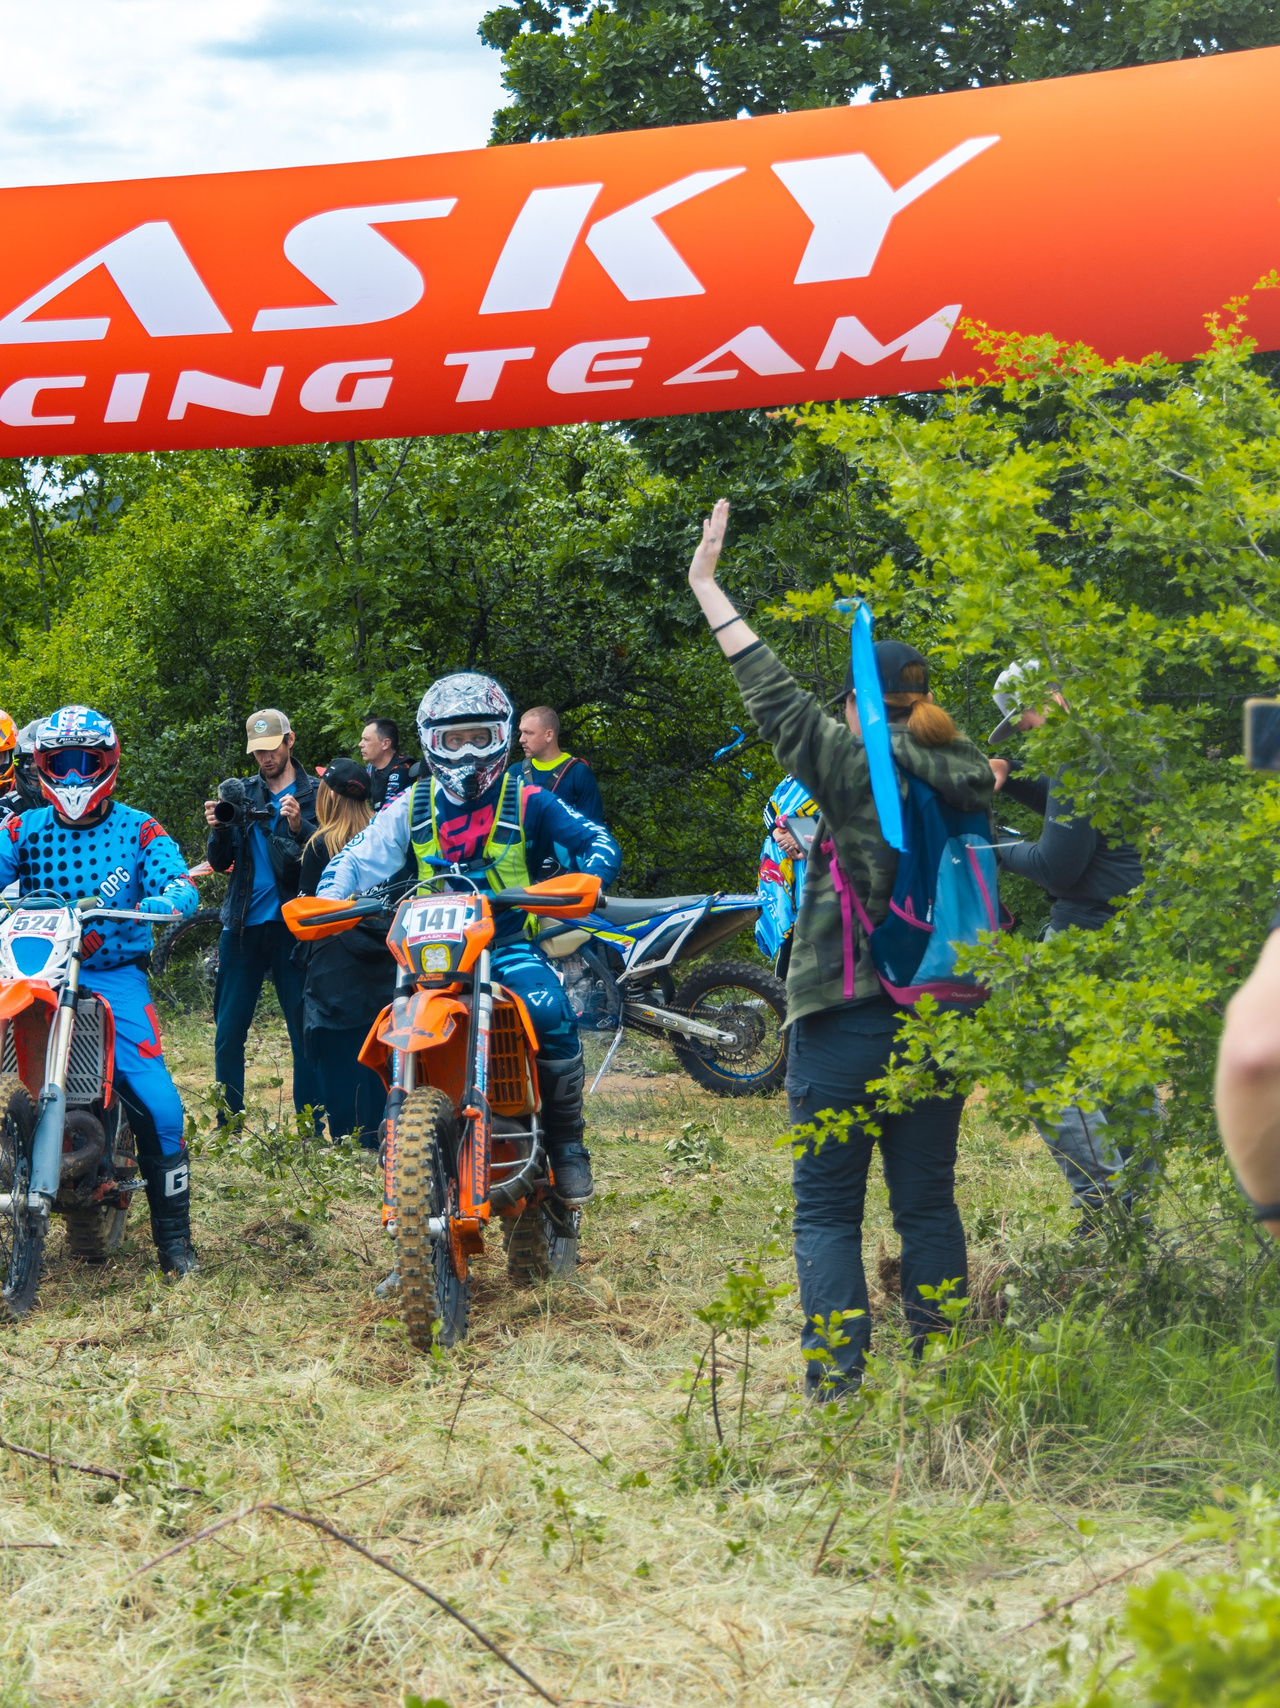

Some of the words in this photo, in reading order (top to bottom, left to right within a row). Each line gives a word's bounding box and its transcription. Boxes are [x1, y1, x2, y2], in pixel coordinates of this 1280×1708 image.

[444, 303, 963, 403] TEAM
[100, 866, 131, 898] OPG
[13, 915, 60, 931] 524
[417, 907, 457, 933] 141
[474, 1116, 486, 1199] DUNLOP
